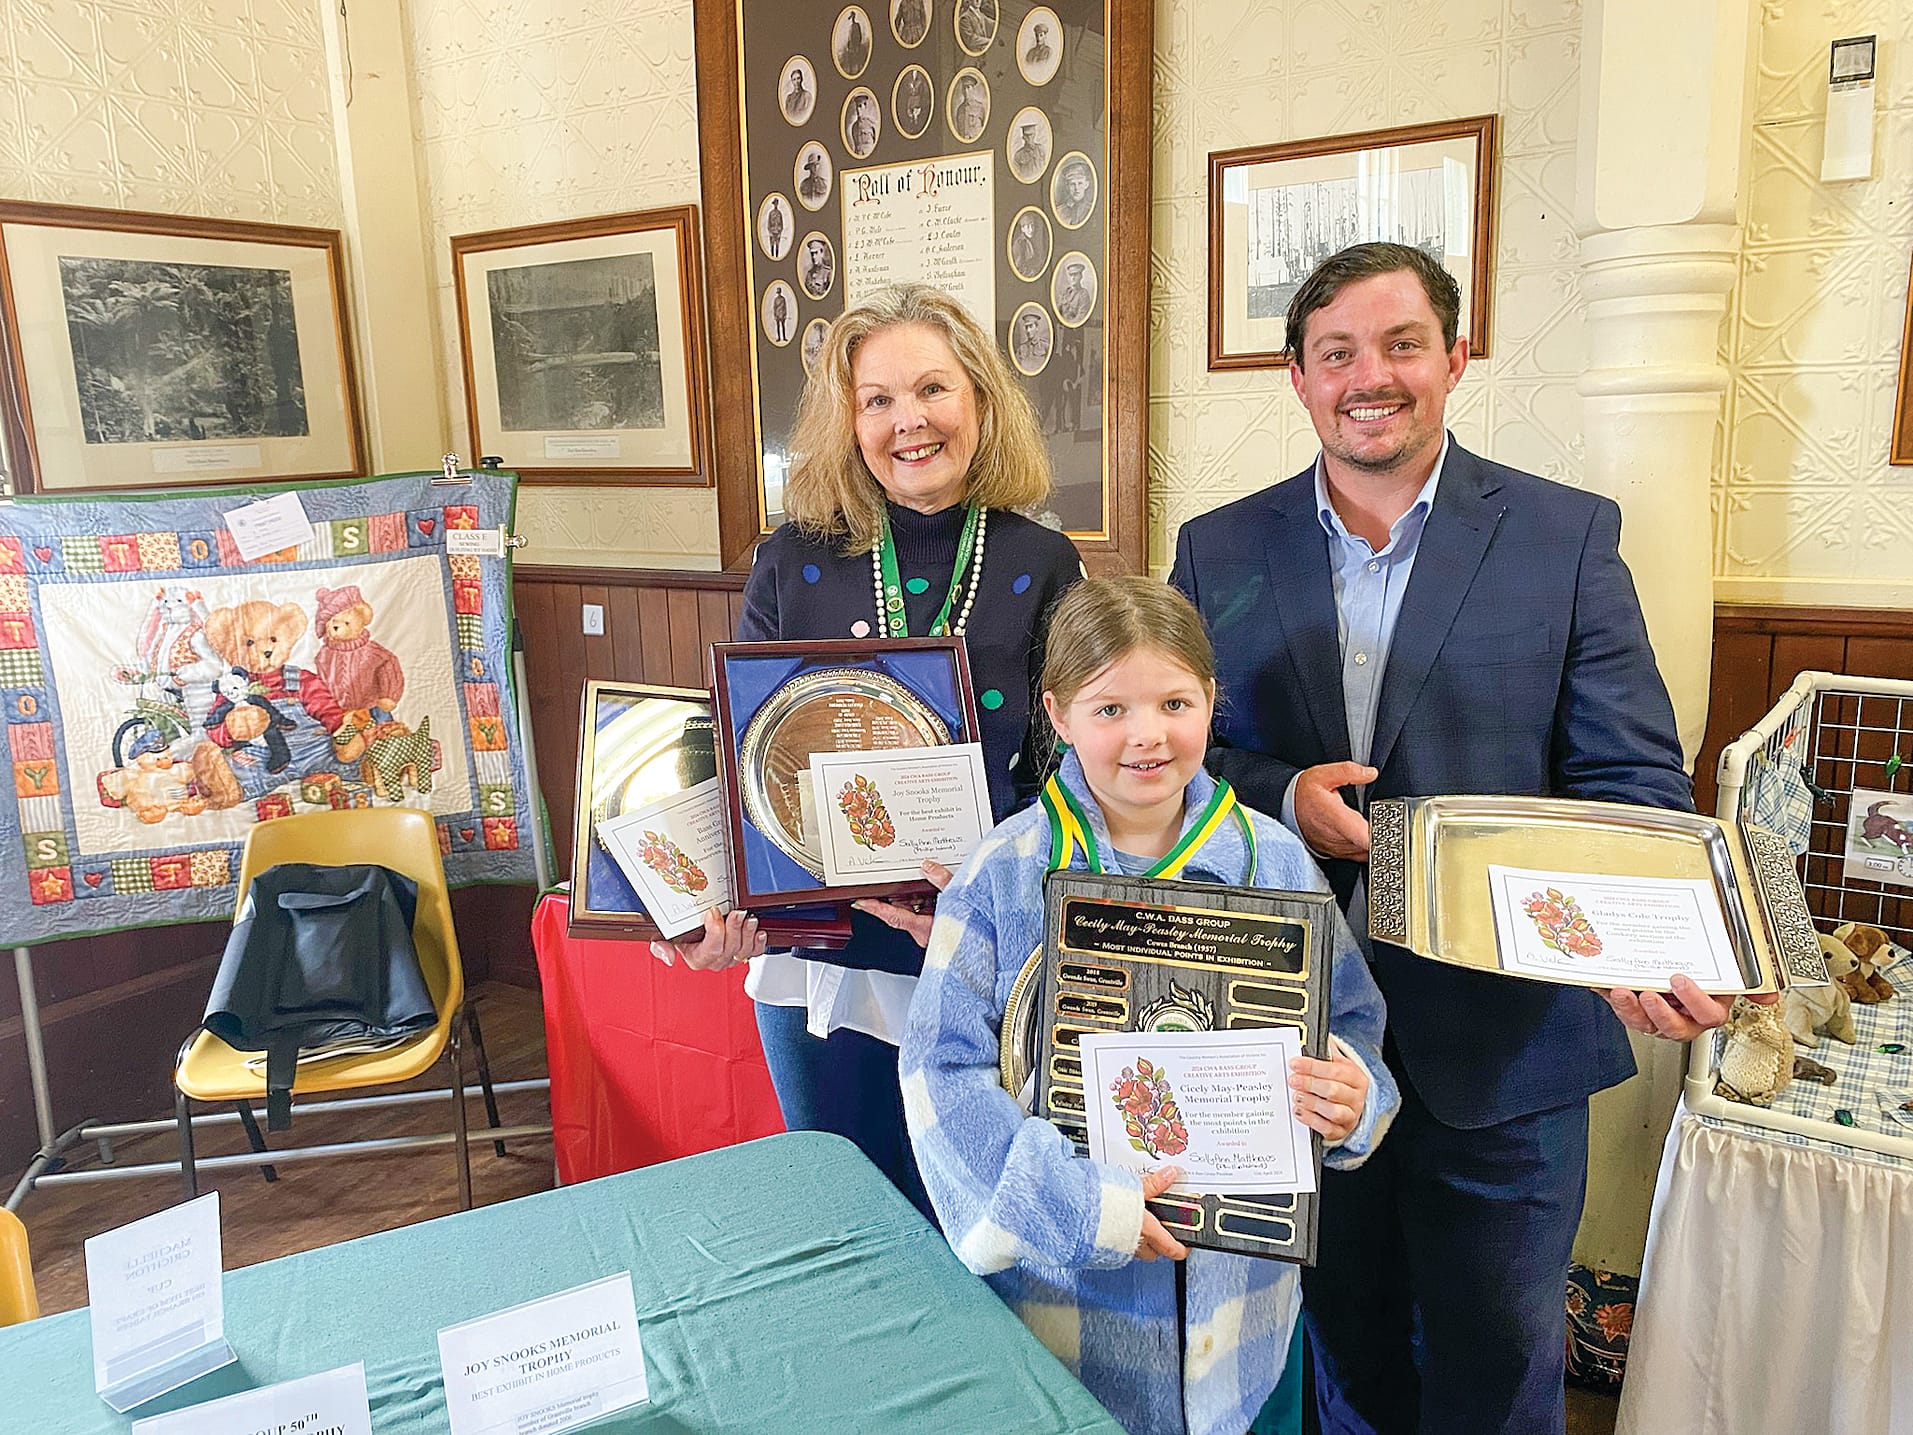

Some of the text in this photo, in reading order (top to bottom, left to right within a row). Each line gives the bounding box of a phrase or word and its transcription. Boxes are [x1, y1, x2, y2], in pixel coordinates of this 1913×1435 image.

[853, 173, 890, 206] Roll
[897, 169, 913, 193] of
[109, 526, 360, 565] T O S
[452, 533, 480, 541] CLASS
[24, 768, 48, 790] Y
[892, 784, 963, 798] Joy Snooks Memorial
[916, 795, 942, 804] Trophy
[489, 791, 506, 813] S
[38, 839, 58, 861] S
[1196, 918, 1231, 928] GROUP
[1592, 910, 1626, 918] Gladys
[1651, 913, 1689, 922] Trophy
[1169, 941, 1193, 951] Branch
[1189, 927, 1249, 944] Memorial
[1250, 933, 1297, 953] Trophy
[1127, 945, 1172, 957] INDIVIDUAL
[1174, 951, 1204, 960] POINTS
[1206, 954, 1214, 962] IN
[1217, 955, 1264, 967] EXHIBITION
[1180, 1083, 1209, 1094] Cicely
[1185, 1093, 1271, 1104] Memorial Trophy
[1223, 1118, 1247, 1127] points
[1246, 1109, 1274, 1118] gaining
[464, 1320, 621, 1377] JOY SNOOKS MEMORIAL
[518, 1349, 573, 1375] TROPHY
[471, 1347, 622, 1402] BEST EXHIBIT IN HOME PRODUCTS
